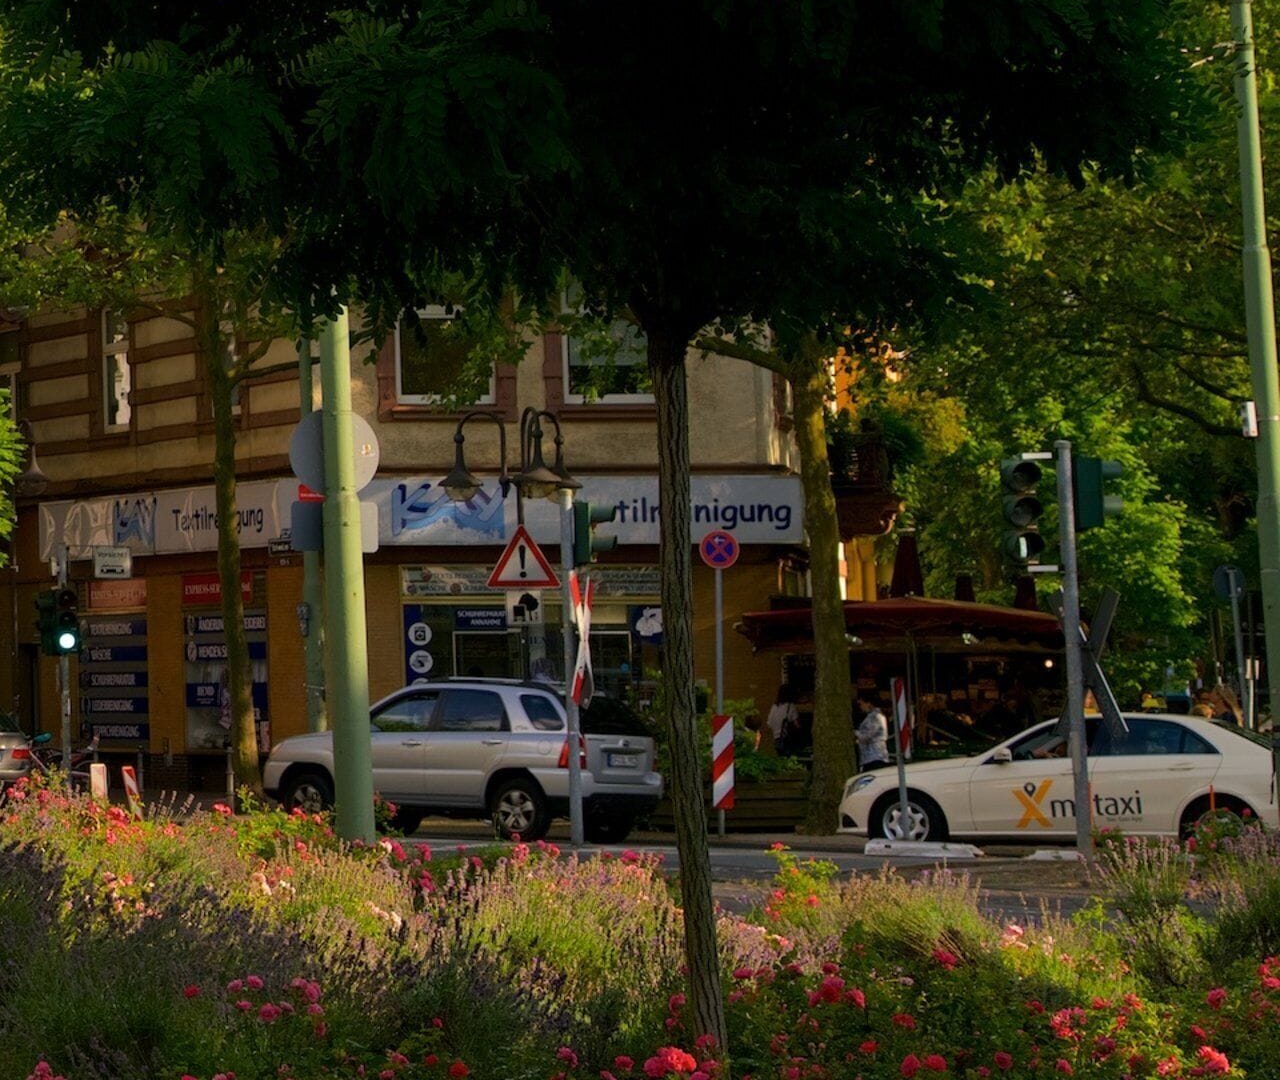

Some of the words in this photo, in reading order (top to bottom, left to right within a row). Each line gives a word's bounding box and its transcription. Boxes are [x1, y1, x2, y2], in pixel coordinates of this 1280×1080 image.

[172, 506, 264, 534] Textilregung
[616, 497, 791, 530] tilrnigung
[1050, 789, 1143, 818] mtaxi
